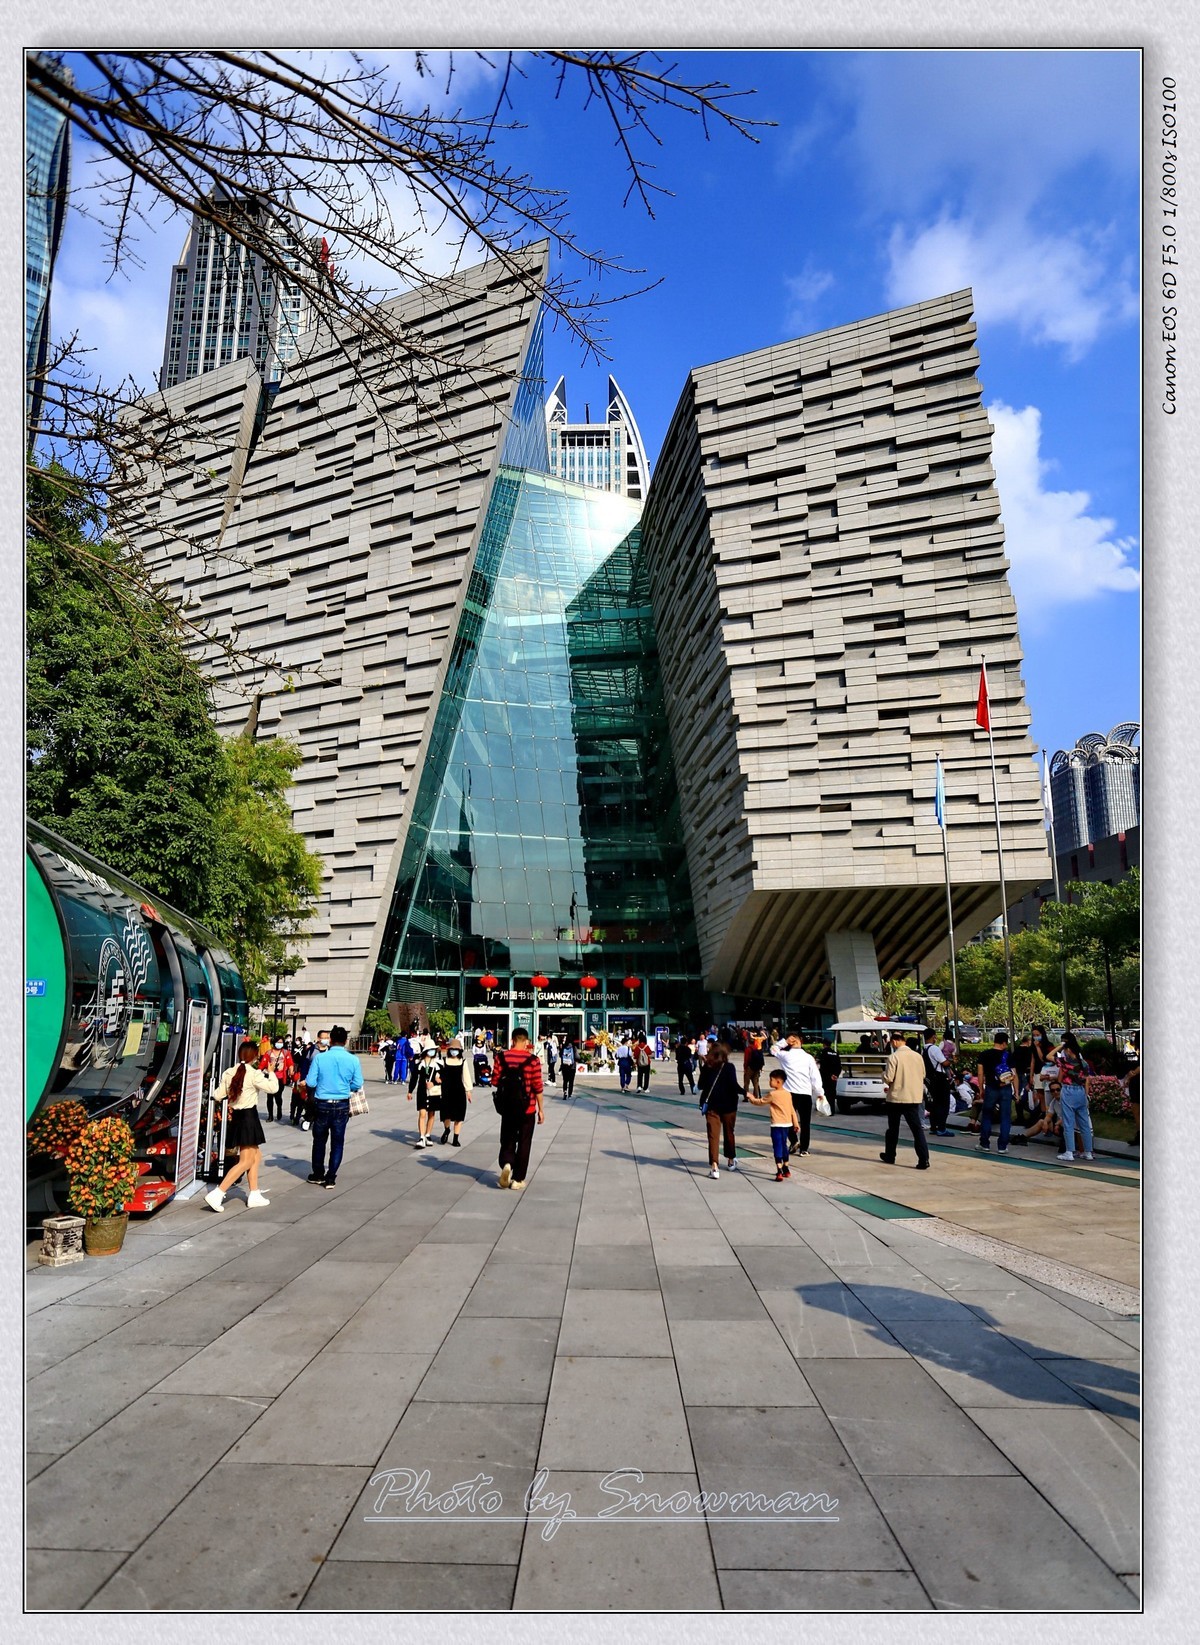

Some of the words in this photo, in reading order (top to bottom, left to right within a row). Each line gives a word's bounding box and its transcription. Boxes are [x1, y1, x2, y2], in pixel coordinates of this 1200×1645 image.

[491, 990, 535, 1001] 广州图书馆
[538, 992, 588, 1001] GUANGZHOU
[590, 993, 620, 1001] LIBRARY
